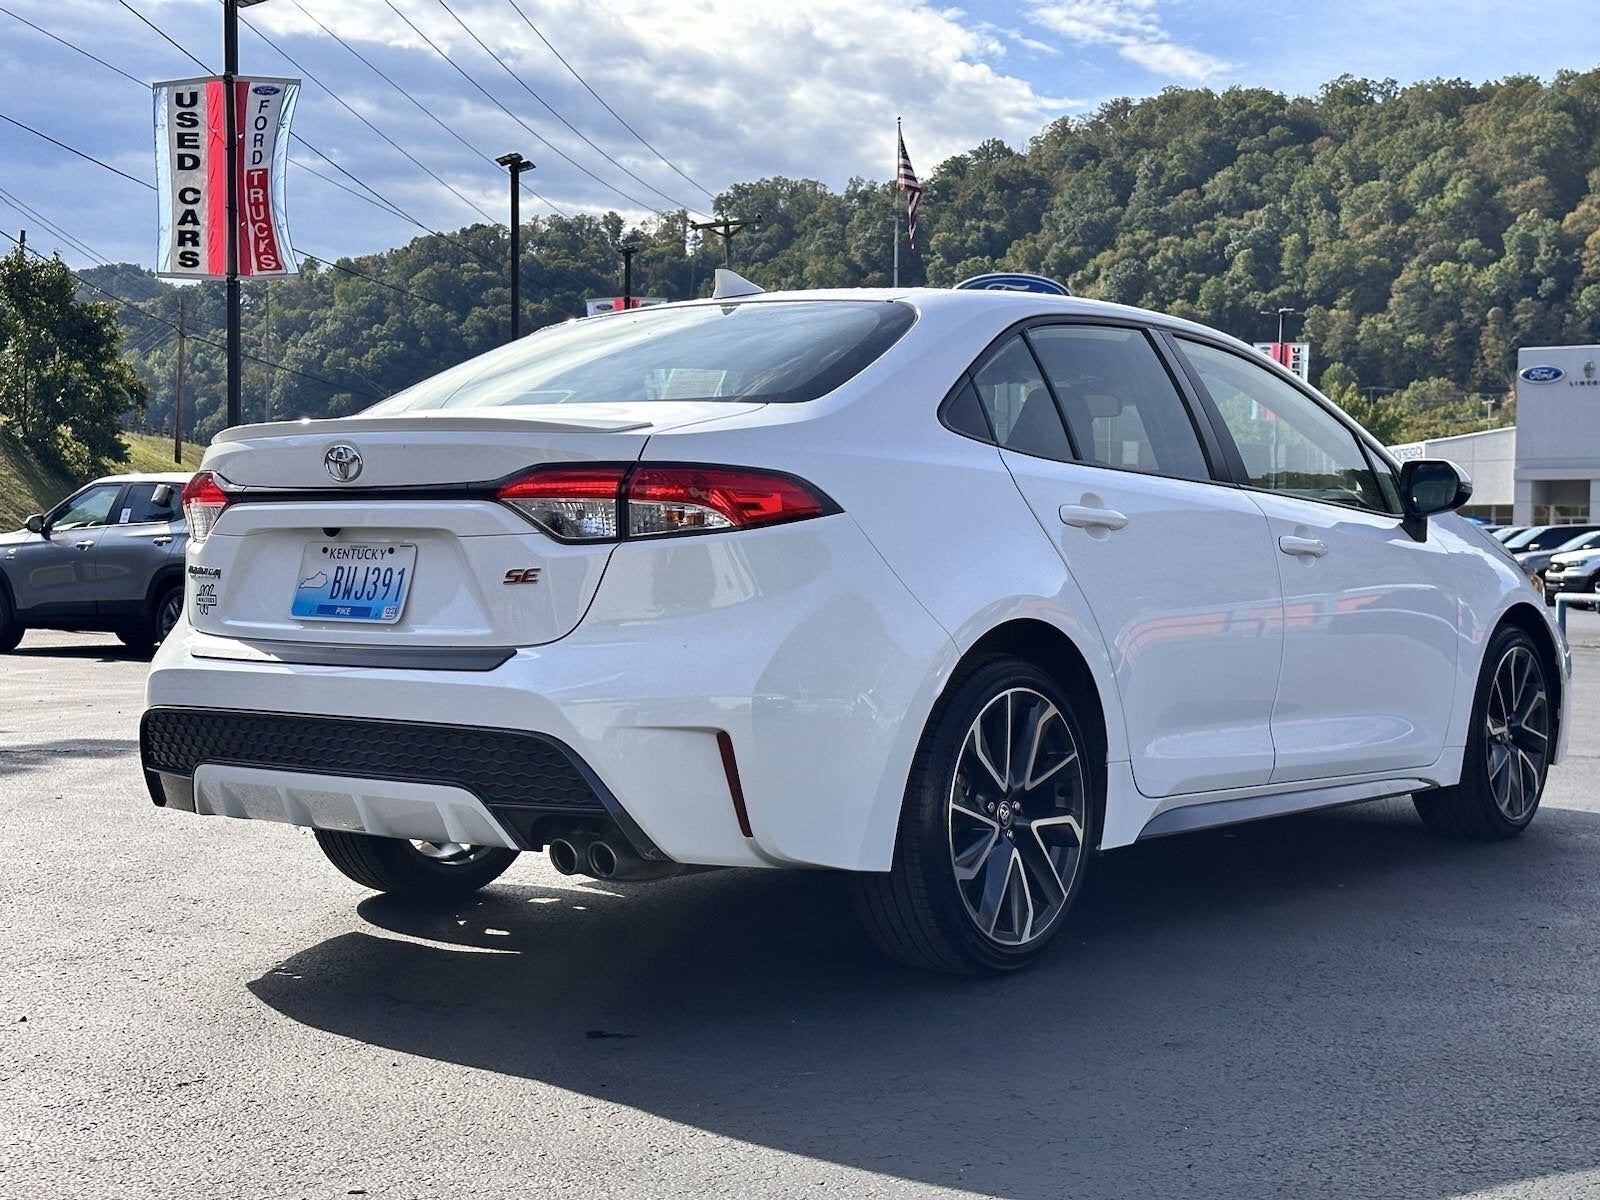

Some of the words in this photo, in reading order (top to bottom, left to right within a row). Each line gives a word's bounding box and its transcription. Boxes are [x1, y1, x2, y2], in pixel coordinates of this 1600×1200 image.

[175, 91, 201, 171] USED
[252, 100, 270, 165] FORD
[177, 187, 201, 268] CARS
[250, 170, 277, 269] TRUCKS
[329, 548, 387, 560] KENTUCKY
[503, 568, 541, 584] SE
[329, 566, 406, 602] BWJ391
[335, 607, 352, 615] PIKE
